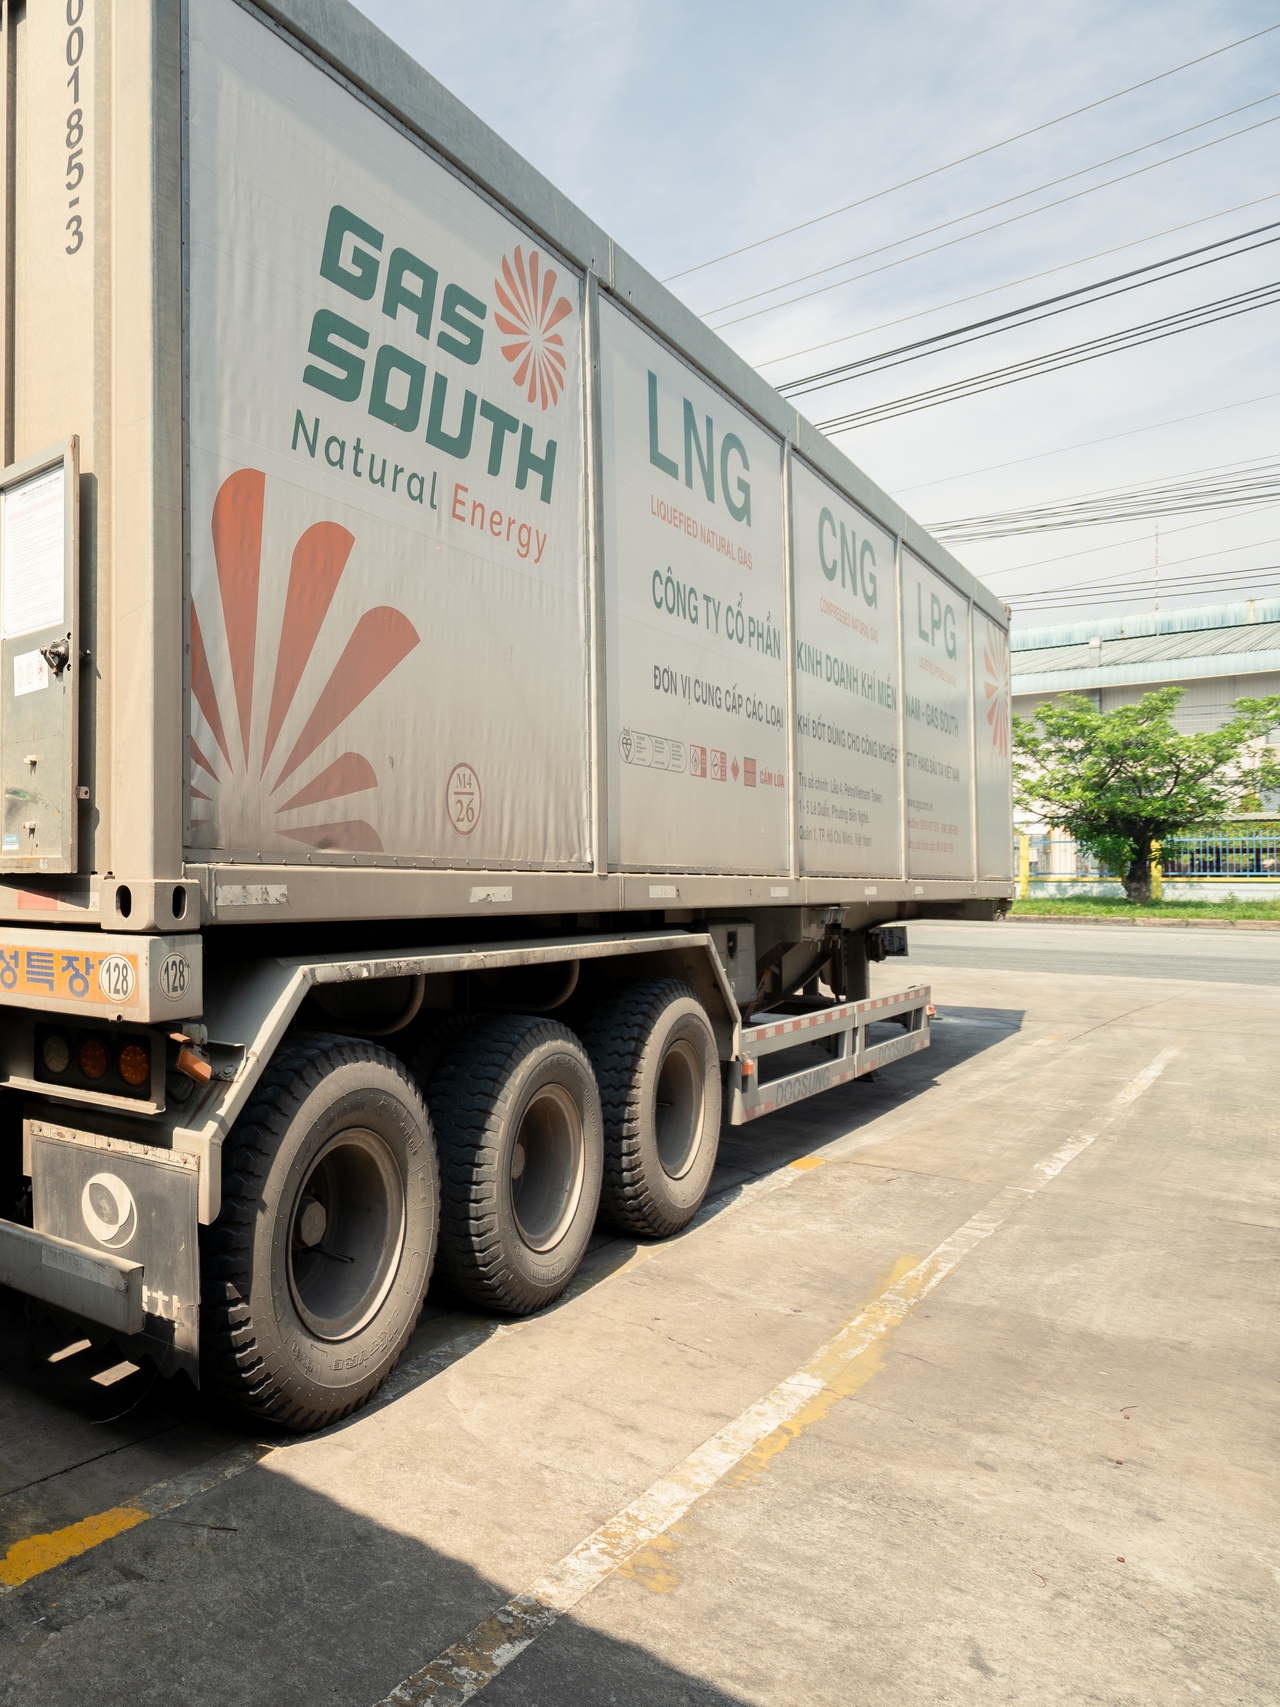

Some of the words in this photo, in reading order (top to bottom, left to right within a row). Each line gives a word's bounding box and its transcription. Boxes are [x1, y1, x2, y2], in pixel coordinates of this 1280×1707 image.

[319, 204, 488, 366] GAS
[302, 308, 557, 505] SOUTH
[648, 368, 752, 528] LNG
[291, 408, 438, 510] Natural
[451, 482, 547, 564] Energy
[651, 494, 698, 539] LIQUEFIED
[700, 524, 736, 561] NATURAL
[737, 547, 753, 570] GAS
[818, 507, 878, 610] CNG
[652, 565, 698, 625] CÔNG
[702, 593, 721, 634] TY
[725, 591, 745, 645] CỔ
[748, 610, 781, 661] PHẦN
[917, 581, 957, 661] LPG
[653, 664, 677, 696] ĐƠN
[680, 674, 691, 705] VỊ
[693, 678, 722, 710] CUNG
[724, 683, 743, 715] CẤP
[745, 693, 763, 722] CÁC
[765, 702, 784, 732] LOẠI
[796, 639, 822, 679] KINH
[826, 653, 858, 694] DOANH
[861, 669, 875, 702] KHÍ
[797, 712, 810, 737] KHÍ
[847, 731, 860, 753] CHO
[861, 733, 877, 758] CÔNG
[926, 703, 938, 729] GAS
[940, 709, 959, 738] SOUTH
[456, 773, 472, 789] M4
[456, 798, 475, 823] 26
[106, 962, 129, 996] 128
[164, 959, 186, 994] 128
[878, 1036, 915, 1067] DOOSUNG
[775, 1067, 830, 1109] DOOSUNG
